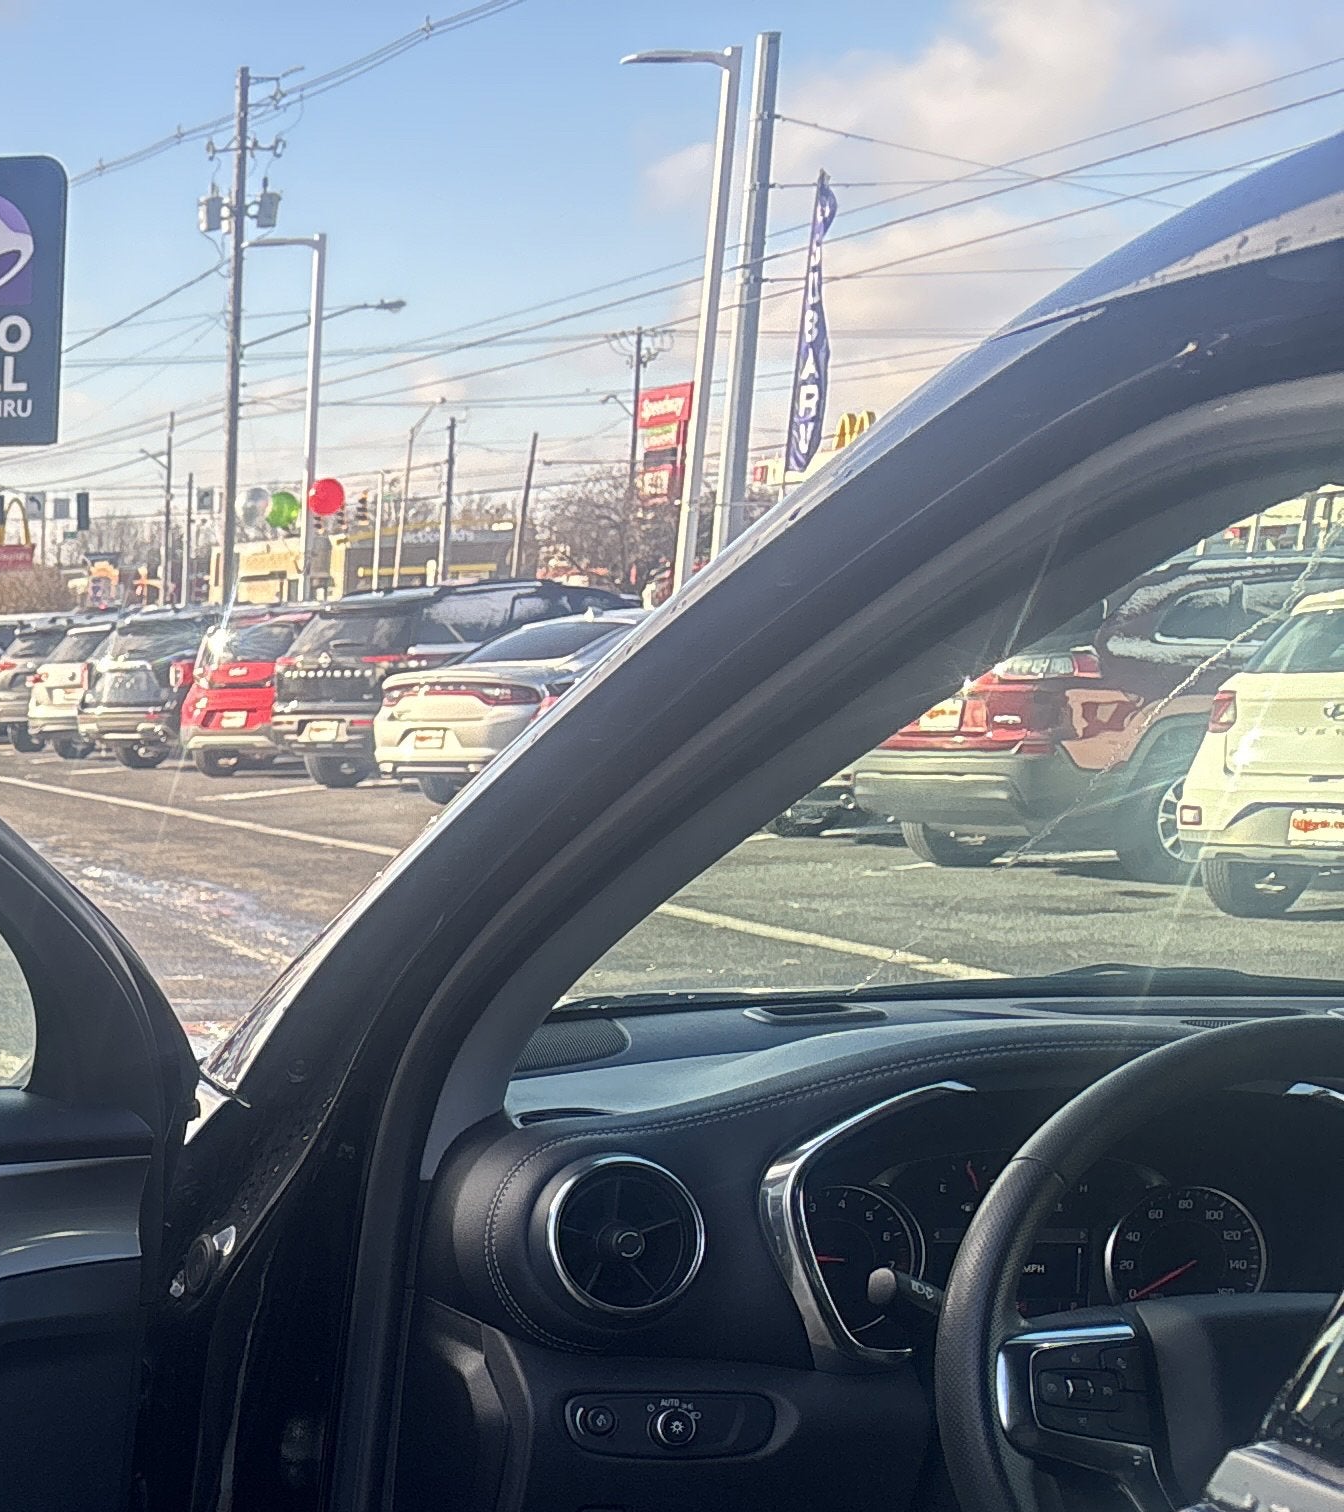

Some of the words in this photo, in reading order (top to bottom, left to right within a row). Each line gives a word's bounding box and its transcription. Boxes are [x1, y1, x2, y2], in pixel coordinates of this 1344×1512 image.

[809, 1203, 817, 1212] 3
[838, 1199, 846, 1208] 4
[1178, 1199, 1194, 1209] 80
[865, 1211, 874, 1221] 5
[1148, 1209, 1163, 1219] 60
[1205, 1210, 1224, 1220] 100
[882, 1231, 891, 1241] 6
[1125, 1232, 1140, 1241] 40
[1223, 1230, 1241, 1240] 120
[1119, 1260, 1134, 1270] 20
[1229, 1260, 1247, 1270] 140
[660, 1398, 680, 1407] AUTO
